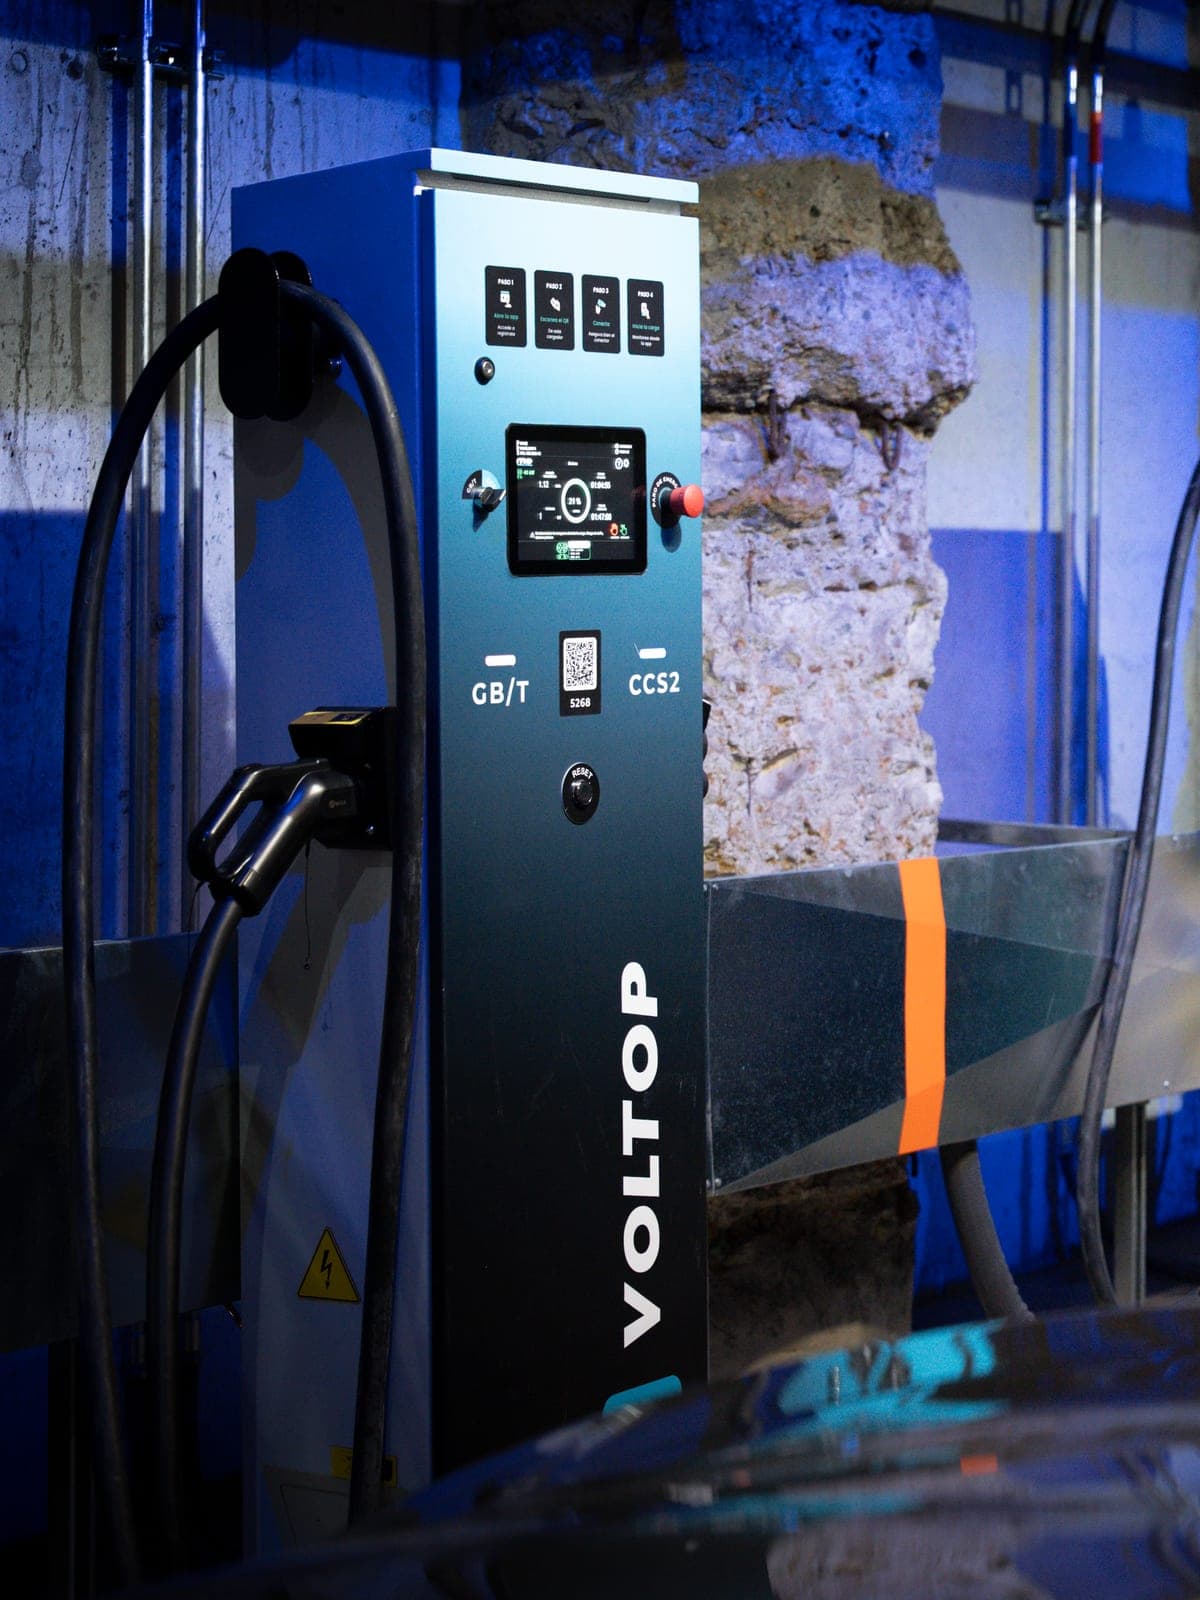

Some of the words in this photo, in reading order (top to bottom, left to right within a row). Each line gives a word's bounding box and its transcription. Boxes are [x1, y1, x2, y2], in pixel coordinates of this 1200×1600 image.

[497, 278, 511, 286] PASO
[545, 282, 558, 290] PASO
[592, 286, 605, 294] PASO
[637, 290, 649, 298] PASO
[628, 671, 681, 696] CCS2
[472, 676, 530, 707] GB/T
[569, 697, 591, 708] 5268
[571, 767, 593, 779] RESET
[621, 961, 661, 1348] VOLTOP
